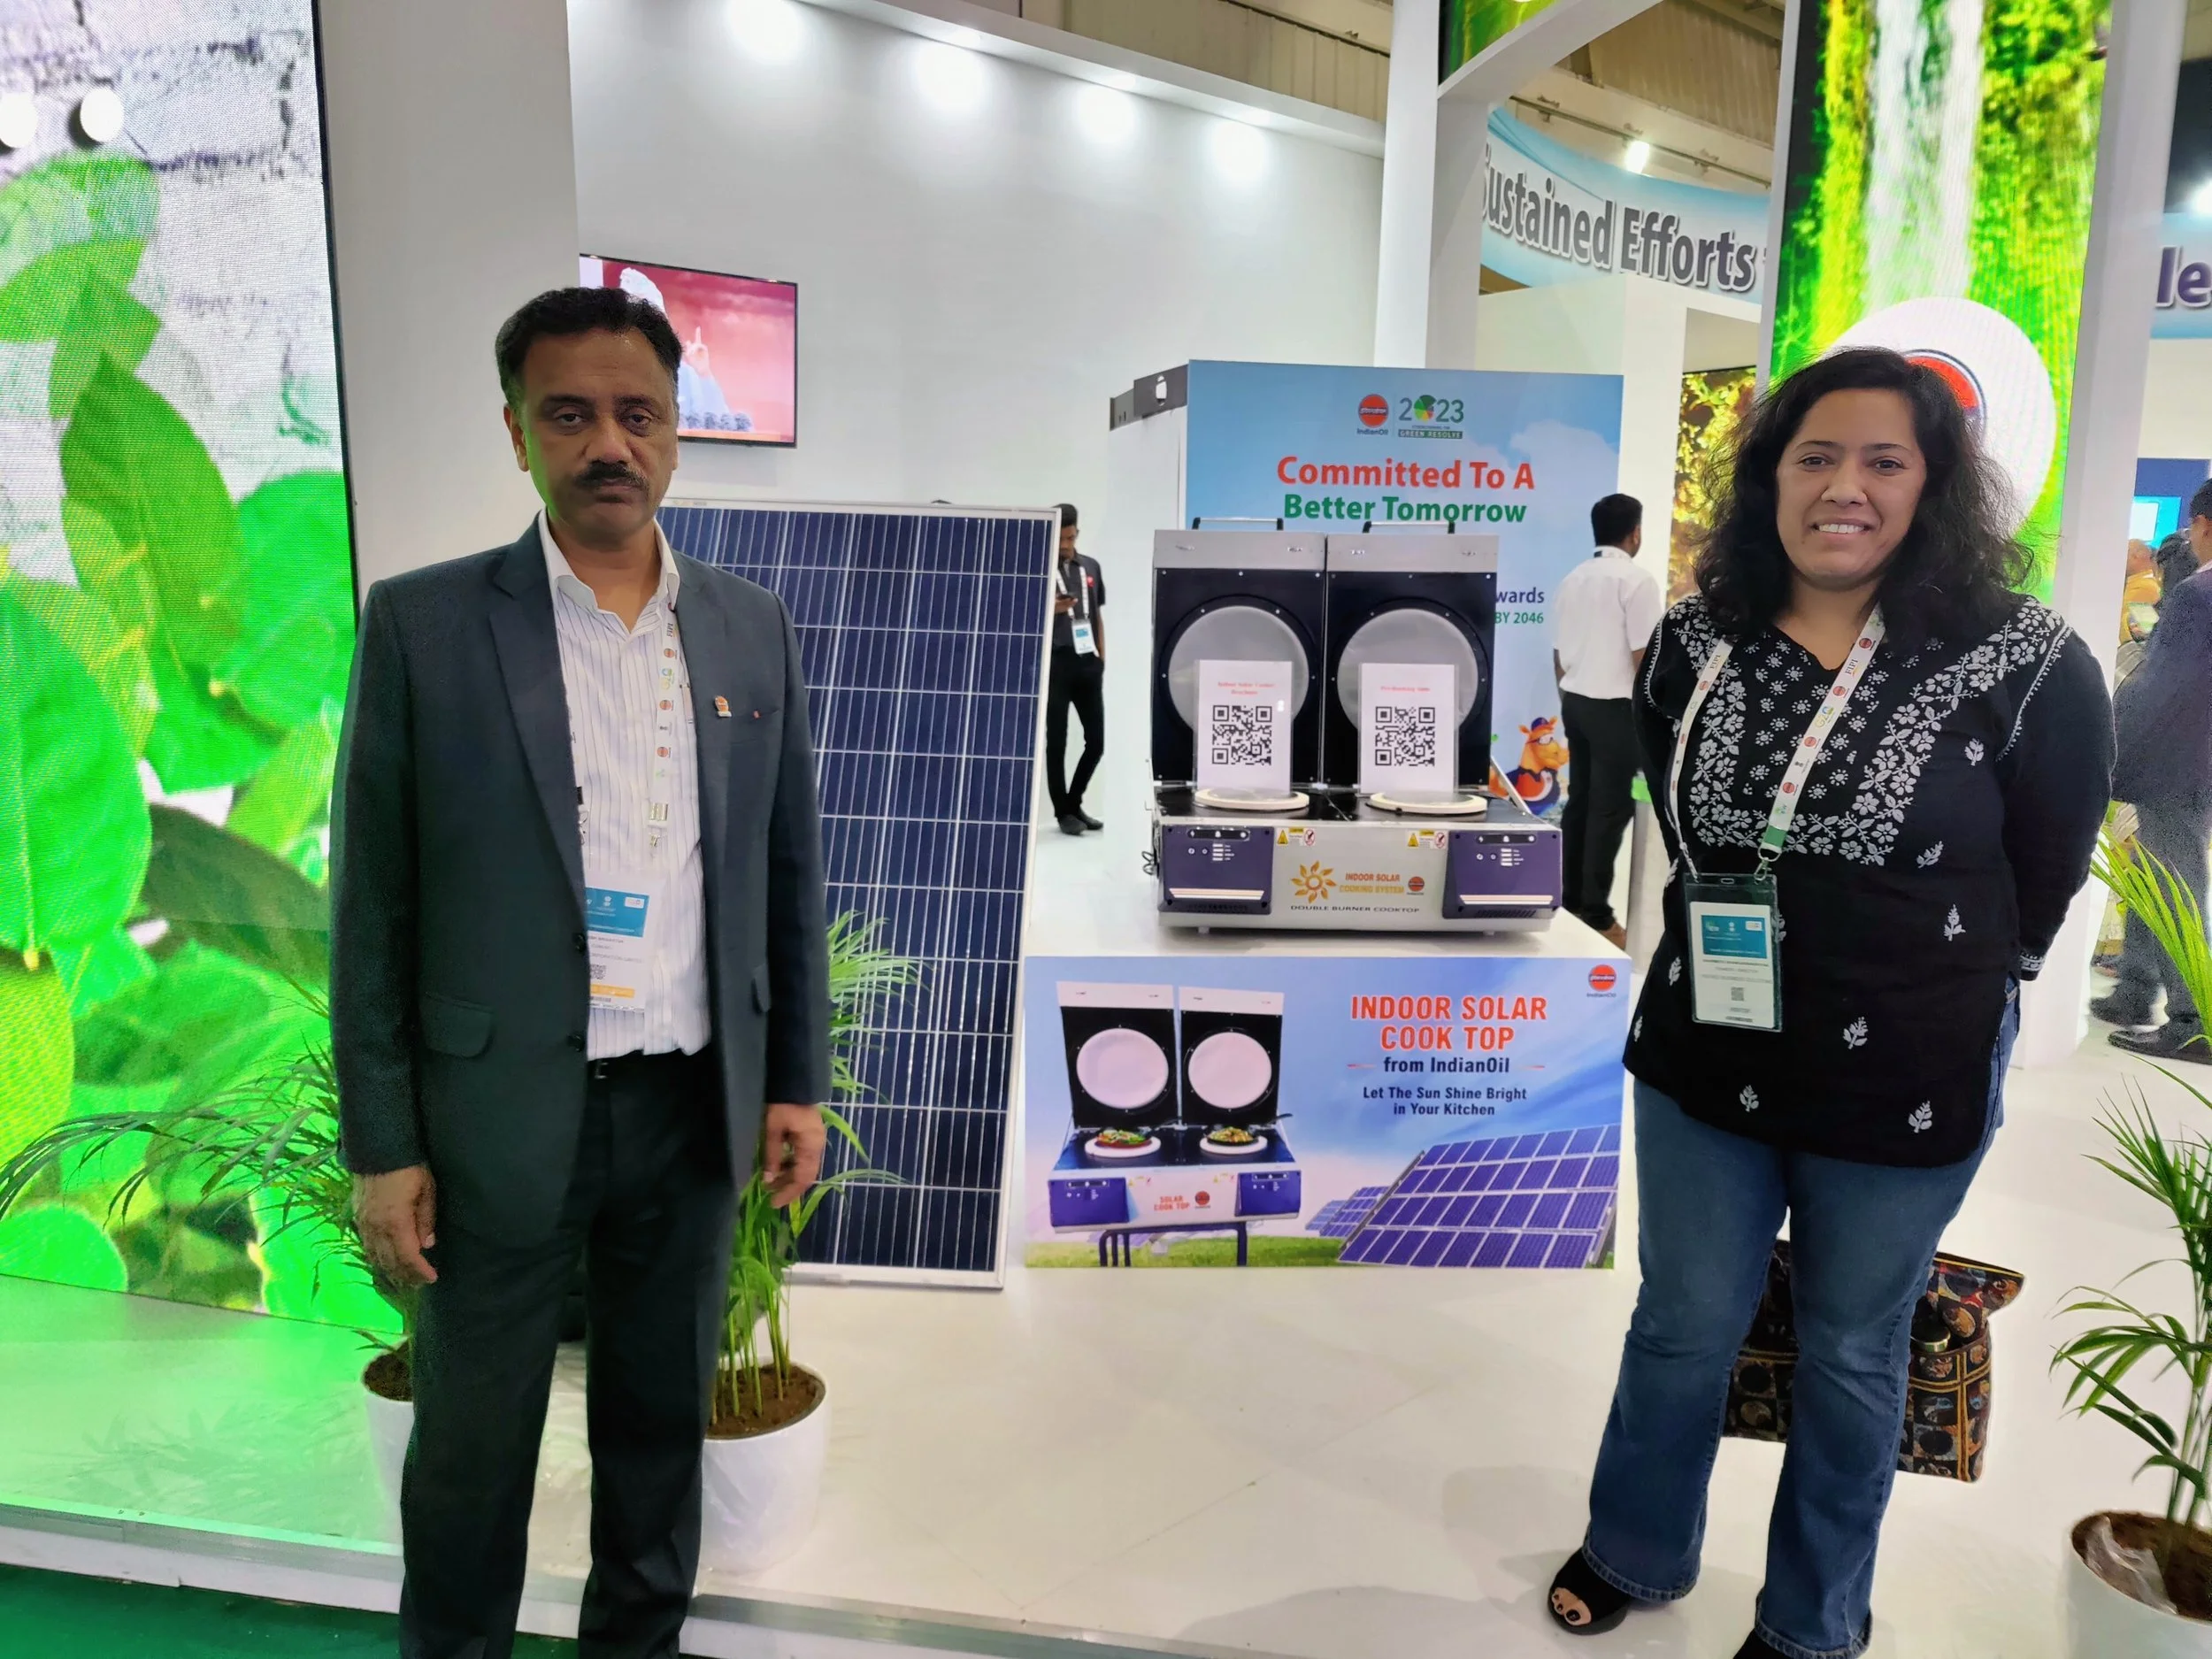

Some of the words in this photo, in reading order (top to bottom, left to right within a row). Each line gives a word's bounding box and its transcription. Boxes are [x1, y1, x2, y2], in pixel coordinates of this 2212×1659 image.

[1621, 207, 1755, 288] Efforts
[1277, 456, 1462, 488] Committed
[1469, 461, 1505, 489] To
[1513, 463, 1535, 489] A
[1284, 494, 1376, 520] Better
[1382, 495, 1527, 523] Tomorrow
[1494, 611, 1509, 624] BY
[1514, 611, 1545, 625] 2046
[1345, 872, 1374, 882] INDOOR
[1376, 873, 1401, 883] SOLAR
[1351, 995, 1452, 1020] INDOOR
[1461, 996, 1548, 1021] SOLAR
[1380, 1026, 1453, 1050] COOK
[1463, 1026, 1515, 1051] TOP
[1383, 1056, 1425, 1073] from
[1430, 1057, 1510, 1073] IndianOil
[1363, 1087, 1384, 1100] Let
[1388, 1087, 1412, 1100] The
[1417, 1087, 1441, 1100] Sun
[1445, 1087, 1482, 1100] Shine
[1486, 1087, 1527, 1103] Bright
[1394, 1102, 1406, 1116] in
[1410, 1103, 1440, 1116] Your
[1443, 1103, 1495, 1116] Kitchen
